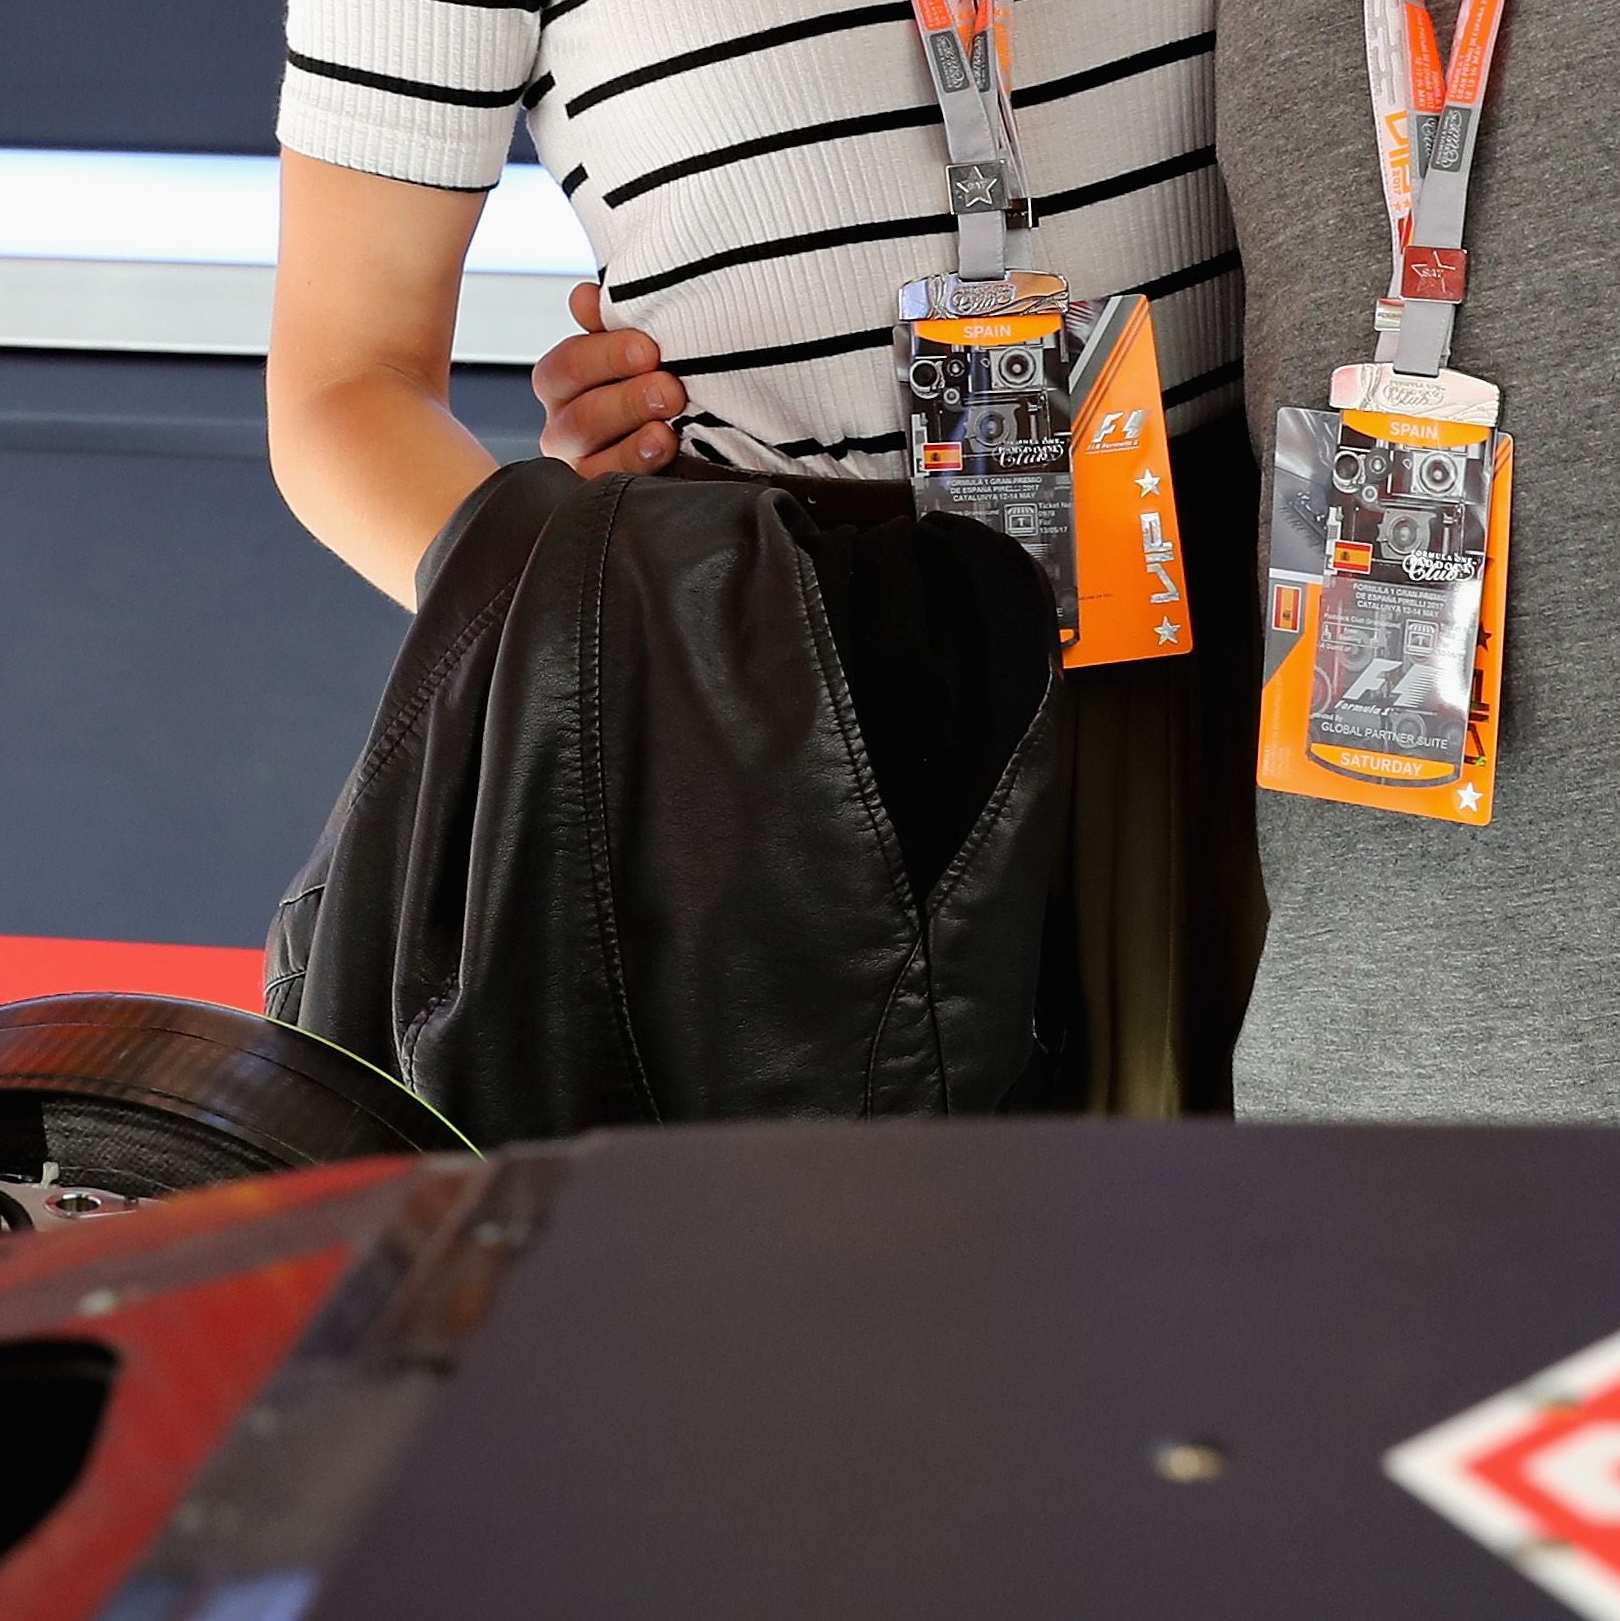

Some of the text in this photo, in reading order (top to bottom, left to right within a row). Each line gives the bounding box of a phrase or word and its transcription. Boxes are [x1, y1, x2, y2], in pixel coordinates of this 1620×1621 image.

[963, 325, 1011, 338] SPAIN
[1090, 411, 1144, 442] F1
[1389, 420, 1439, 441] SPAIN
[1138, 510, 1179, 604] VIP
[1352, 582, 1389, 594] FORMULA
[1395, 588, 1415, 598] GRAN
[1416, 591, 1448, 602] PREMIO
[1355, 591, 1443, 610] DE ESPAÑA PIRELLI 2017
[1356, 599, 1399, 612] CATALUNYA
[1423, 609, 1440, 618] MAY
[1342, 654, 1442, 711] F1
[1334, 700, 1381, 714] Formula
[1320, 721, 1448, 749] GLOBAL PARTNER SUITE
[1339, 752, 1422, 776] SATURDAY
